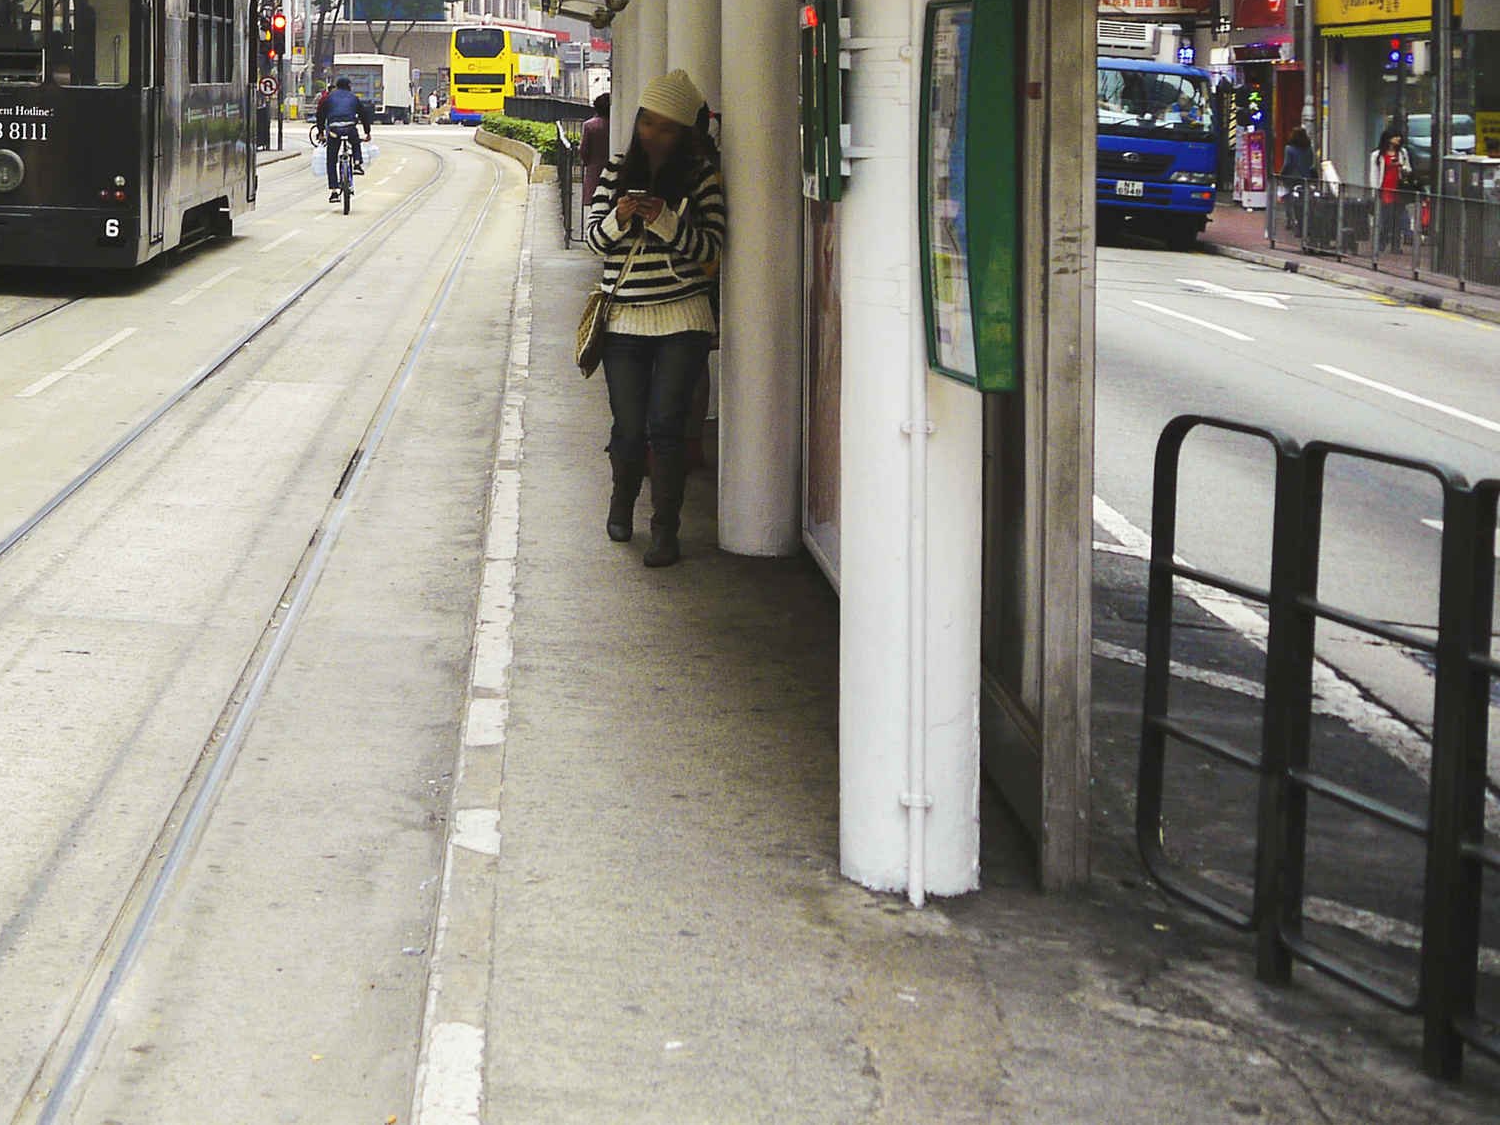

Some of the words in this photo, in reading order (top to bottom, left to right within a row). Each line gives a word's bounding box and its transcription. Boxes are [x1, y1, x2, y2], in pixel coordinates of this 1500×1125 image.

[15, 105, 54, 117] Hotline:
[8, 121, 48, 141] 8111
[104, 218, 120, 237] 6
